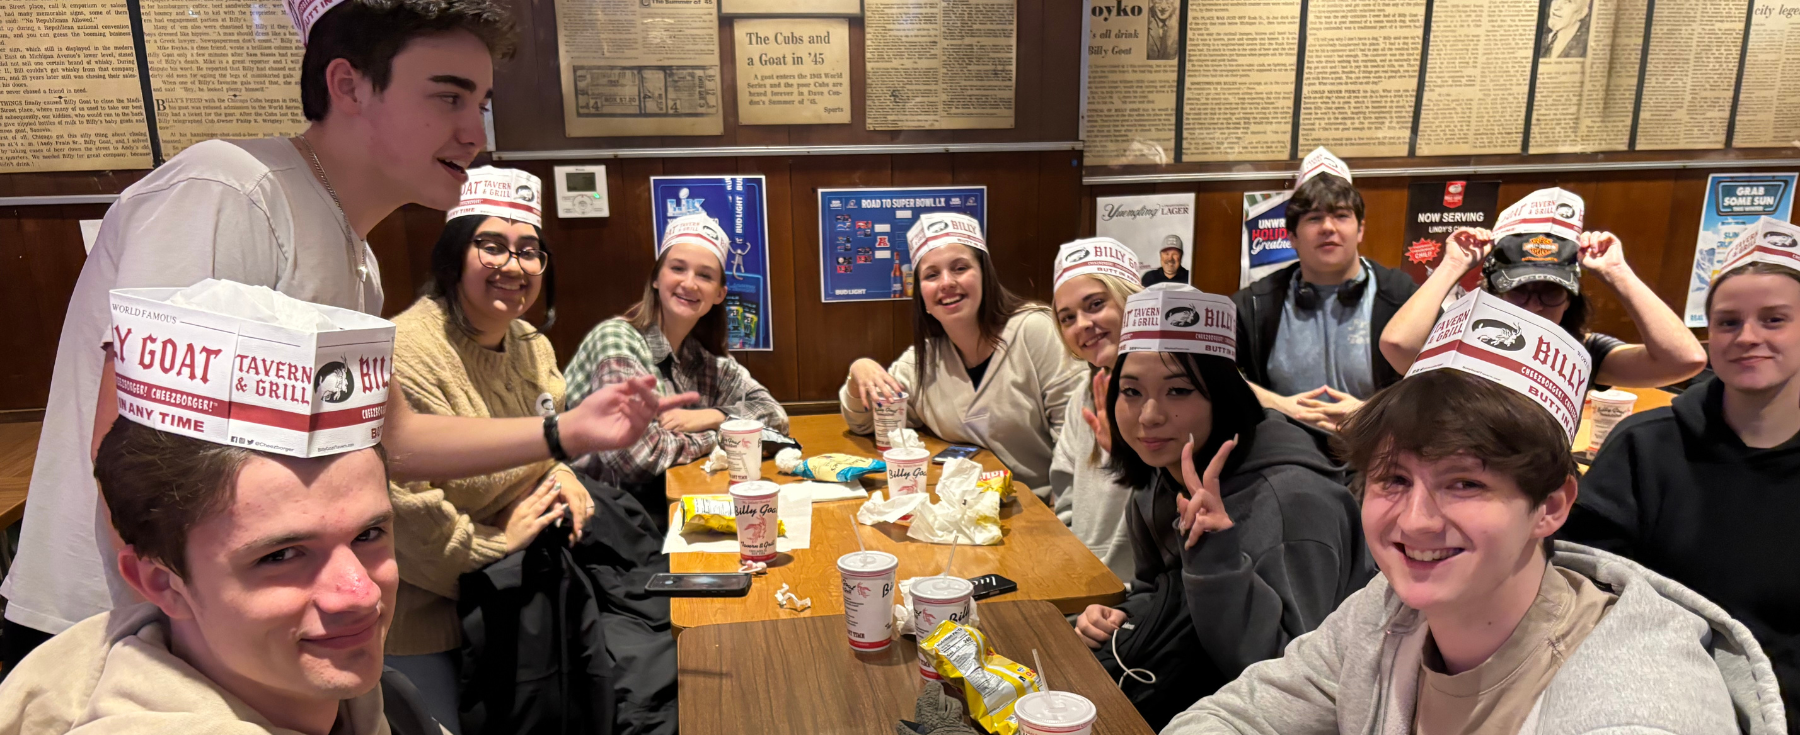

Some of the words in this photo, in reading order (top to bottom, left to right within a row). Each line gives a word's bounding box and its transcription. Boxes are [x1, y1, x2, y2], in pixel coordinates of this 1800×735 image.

[1754, 4, 1775, 19] city
[746, 32, 770, 45] The
[774, 31, 804, 45] Cubs
[808, 31, 831, 45] and
[1099, 29, 1112, 39] all
[1114, 29, 1139, 39] drink
[747, 57, 755, 66] a
[759, 53, 788, 66] Goat
[791, 52, 804, 66] in
[808, 52, 825, 65] '45
[1088, 46, 1109, 59] Billy
[1111, 46, 1132, 55] Goat
[823, 106, 844, 114] Sports
[484, 180, 512, 190] TAVERN
[1736, 187, 1765, 196] GRAB
[861, 199, 881, 209] ROAD
[882, 199, 892, 208] TO
[892, 198, 915, 208] SUPER
[915, 198, 936, 208] BOWL
[935, 198, 946, 207] LX
[1723, 196, 1752, 206] SOME
[1753, 196, 1775, 206] SUN
[1101, 203, 1160, 222] Yuengling
[1161, 207, 1189, 216] LAGER
[1417, 212, 1441, 223] NOW
[1441, 211, 1485, 223] SERVING
[950, 220, 977, 235] BILLY
[1428, 225, 1453, 234] LINDY'S
[1094, 246, 1126, 263] BILLY
[112, 303, 141, 317] WORLD
[141, 310, 177, 325] FAMOUS
[1133, 306, 1160, 317] TAVERN
[1137, 316, 1159, 327] GRILL
[1433, 309, 1471, 334] TAVERN
[1435, 323, 1463, 343] GRILL
[1205, 345, 1226, 353] BUTT
[137, 333, 223, 385] GOAT
[1532, 335, 1586, 397] BILLY
[234, 353, 313, 385] TAVERN
[1521, 366, 1564, 401] CHEEZBORGER!
[235, 376, 248, 393] &
[254, 380, 310, 406] GRILL
[1527, 385, 1562, 415] BUTT
[1561, 413, 1570, 428] IN
[128, 402, 155, 421] ANY
[158, 411, 205, 433] TIME
[888, 468, 911, 479] Billy
[912, 467, 927, 478] Goa
[735, 504, 757, 518] Billy
[759, 504, 778, 516] Goa
